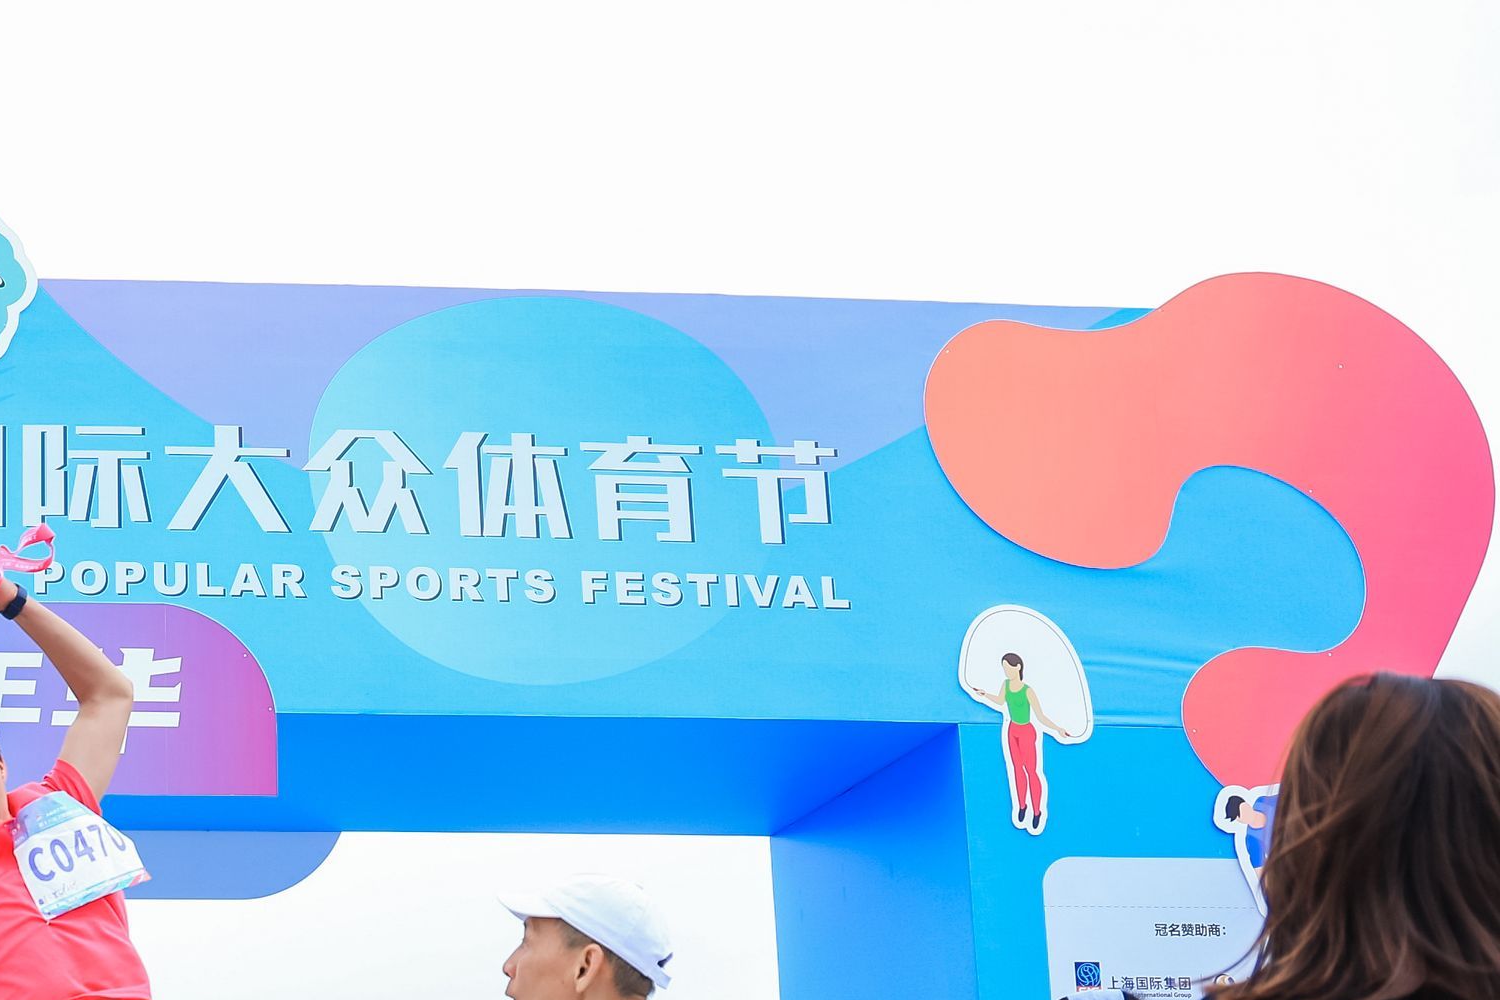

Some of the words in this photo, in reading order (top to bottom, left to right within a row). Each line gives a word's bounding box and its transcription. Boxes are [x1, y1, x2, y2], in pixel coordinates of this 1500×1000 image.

[34, 560, 305, 599] POPULAR
[330, 564, 557, 604] SPORTS
[581, 570, 852, 610] FESTIVAL
[28, 824, 126, 882] C0470
[1108, 976, 1192, 990] 上海国际集团
[1174, 992, 1192, 1000] Group
